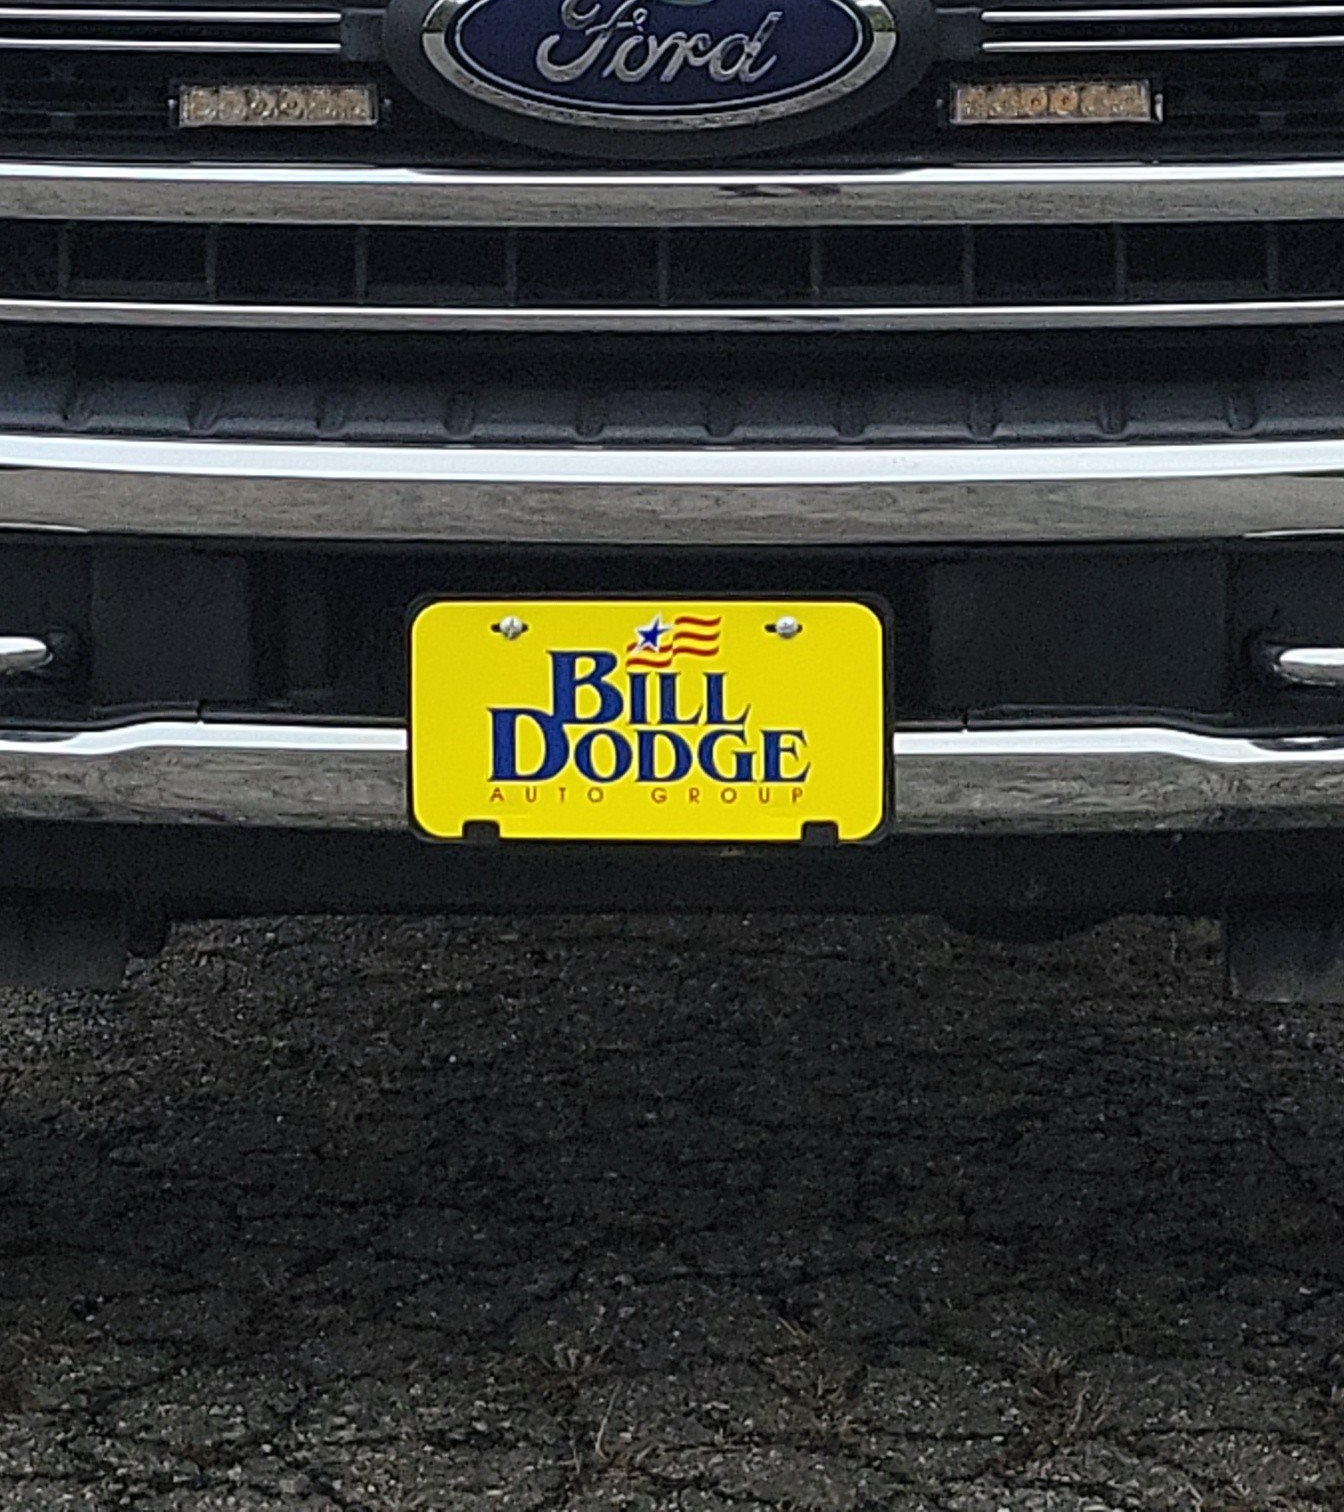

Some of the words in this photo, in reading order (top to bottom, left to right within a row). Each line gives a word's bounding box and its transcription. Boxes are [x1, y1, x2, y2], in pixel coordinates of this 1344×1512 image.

[546, 649, 752, 725] BILL
[487, 706, 812, 783] DODGE
[489, 786, 605, 804] AUTO
[650, 786, 805, 804] GROUP
